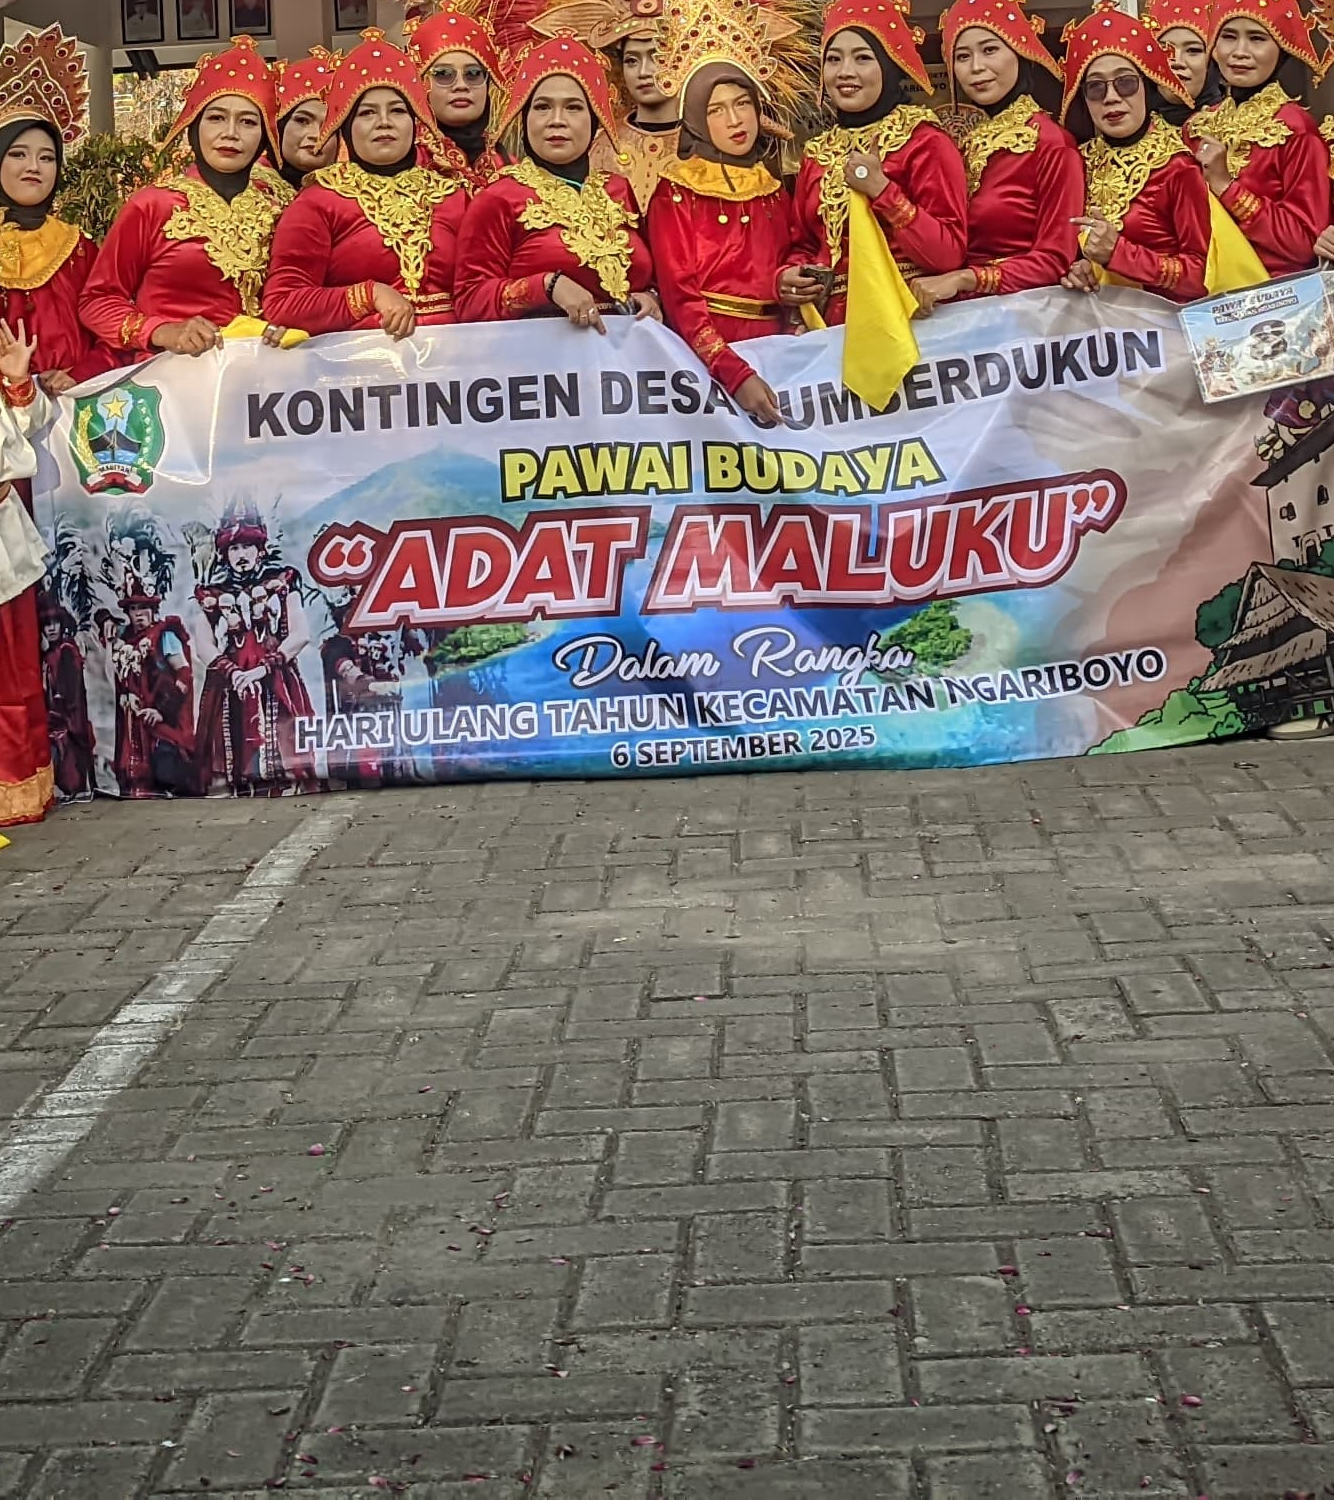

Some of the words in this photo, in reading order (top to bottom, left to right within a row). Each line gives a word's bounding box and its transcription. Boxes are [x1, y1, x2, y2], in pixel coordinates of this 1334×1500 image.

[1249, 319, 1288, 361] 8
[246, 371, 581, 439] KONTINGEN
[599, 369, 740, 417] DESA
[748, 330, 1163, 431] UMERDUKUN
[500, 439, 693, 501] PAWAI
[702, 436, 947, 496] BUDAYA
[554, 634, 721, 687] Dalam
[732, 627, 915, 687] Rangka
[294, 711, 395, 753] HARI
[399, 702, 537, 744] ULANG
[543, 692, 689, 736] TAHUN
[697, 677, 937, 728] KECAMATAN
[942, 646, 1167, 705] NGARIBOYO
[611, 741, 631, 768] 6
[636, 729, 803, 766] SEPTEMBER
[809, 725, 877, 753] 2025
